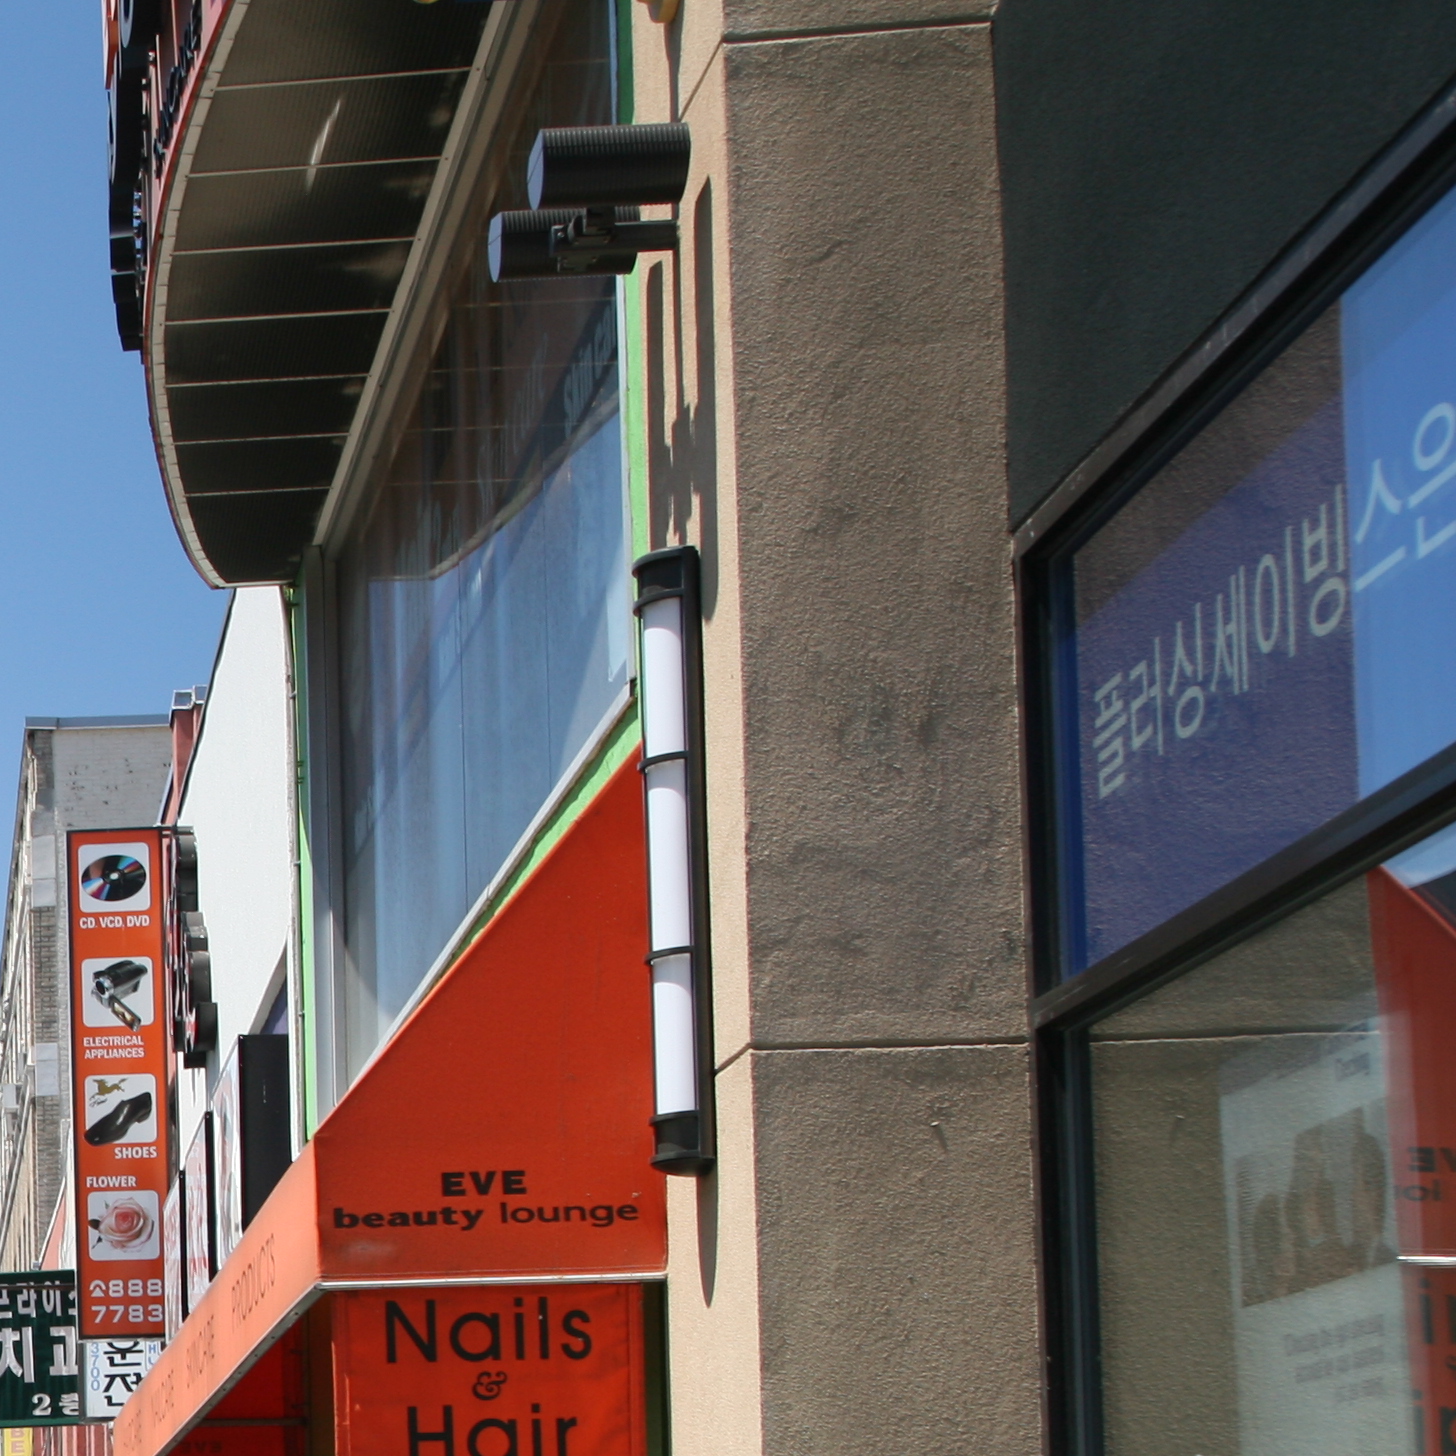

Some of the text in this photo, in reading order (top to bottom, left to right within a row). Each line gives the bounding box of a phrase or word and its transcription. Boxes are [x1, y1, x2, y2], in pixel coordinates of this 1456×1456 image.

[127, 915, 150, 927] DVD
[84, 1048, 145, 1059] APPLIANCES
[114, 1146, 158, 1159] SHOES
[86, 1175, 137, 1188] FLOWER
[441, 1169, 527, 1197] EVE
[333, 1200, 640, 1231] beauty lounge
[109, 1279, 163, 1298] 888
[231, 1232, 276, 1334] PRODUCTS
[91, 1305, 163, 1323] 7783
[385, 1297, 593, 1364] Nails
[472, 1370, 508, 1400] &
